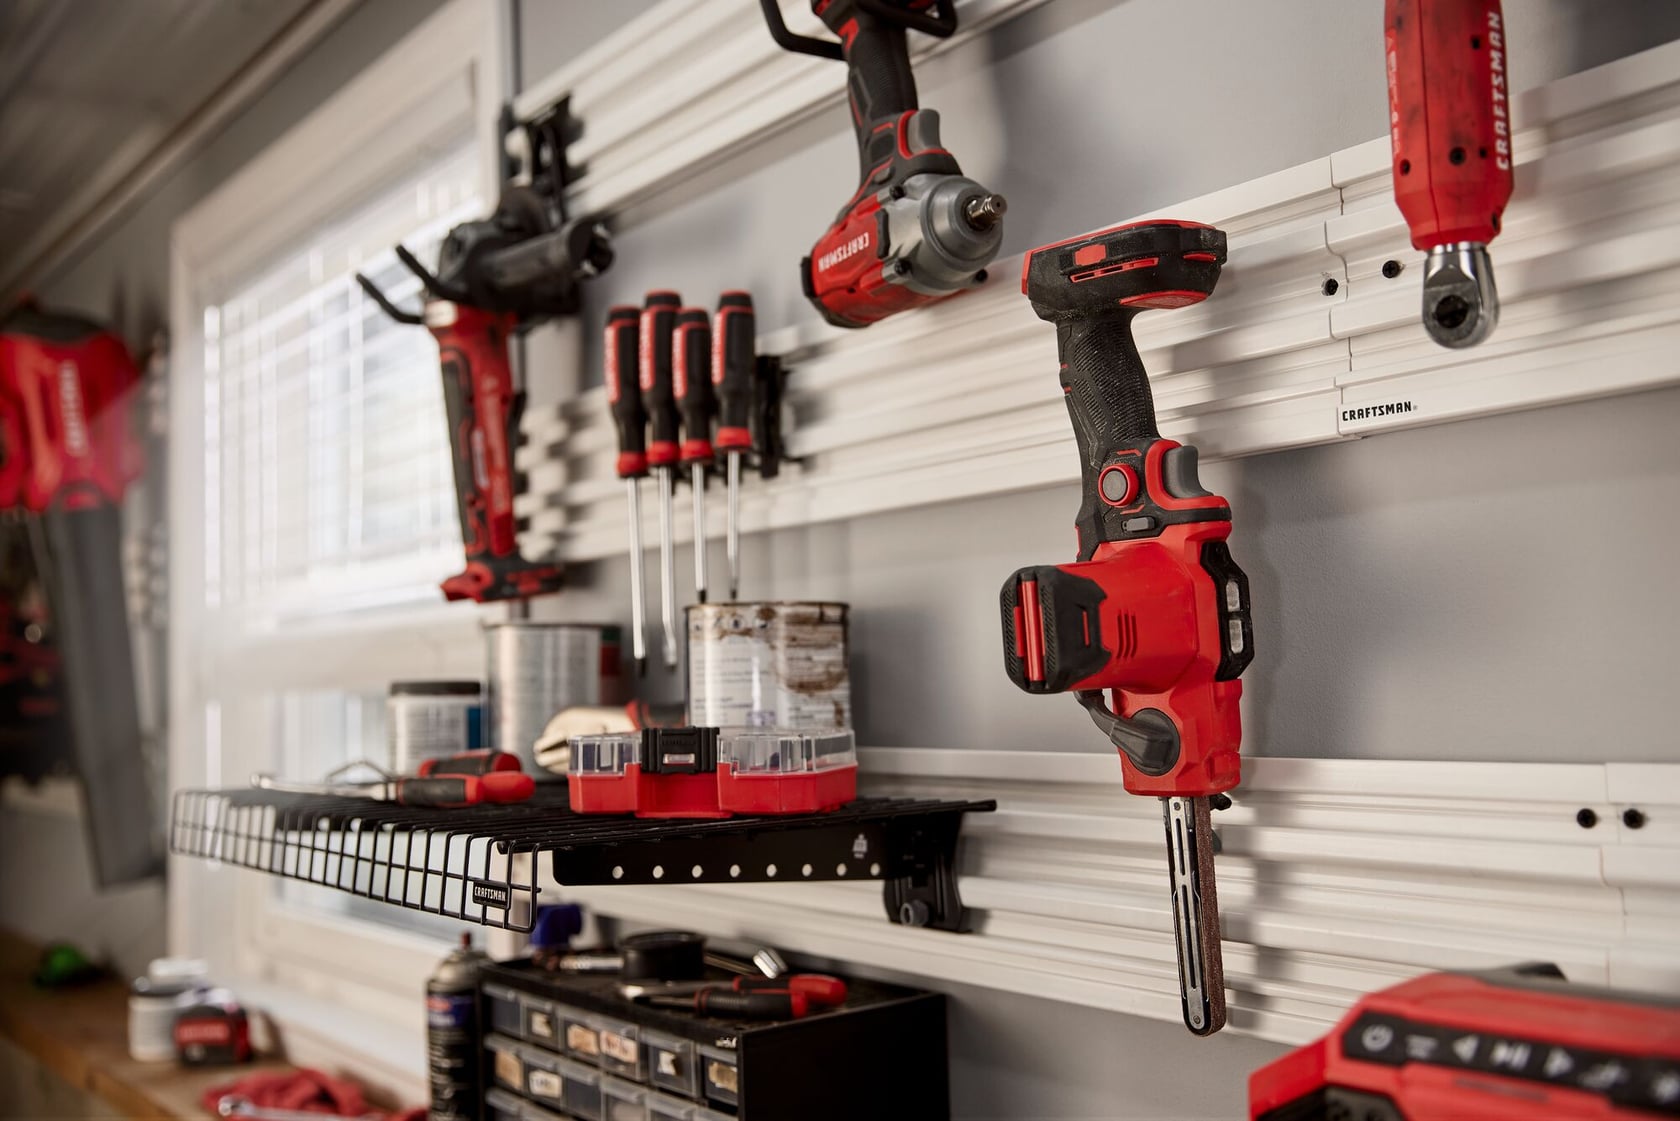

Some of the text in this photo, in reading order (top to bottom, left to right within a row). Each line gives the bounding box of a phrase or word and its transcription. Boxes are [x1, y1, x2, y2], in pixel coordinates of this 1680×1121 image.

[1488, 12, 1509, 170] CRAFTSMAN
[818, 232, 870, 272] CRAFTSMAN
[1342, 401, 1412, 421] CRAFTSMAN
[474, 886, 506, 901] CRAFTSMAN
